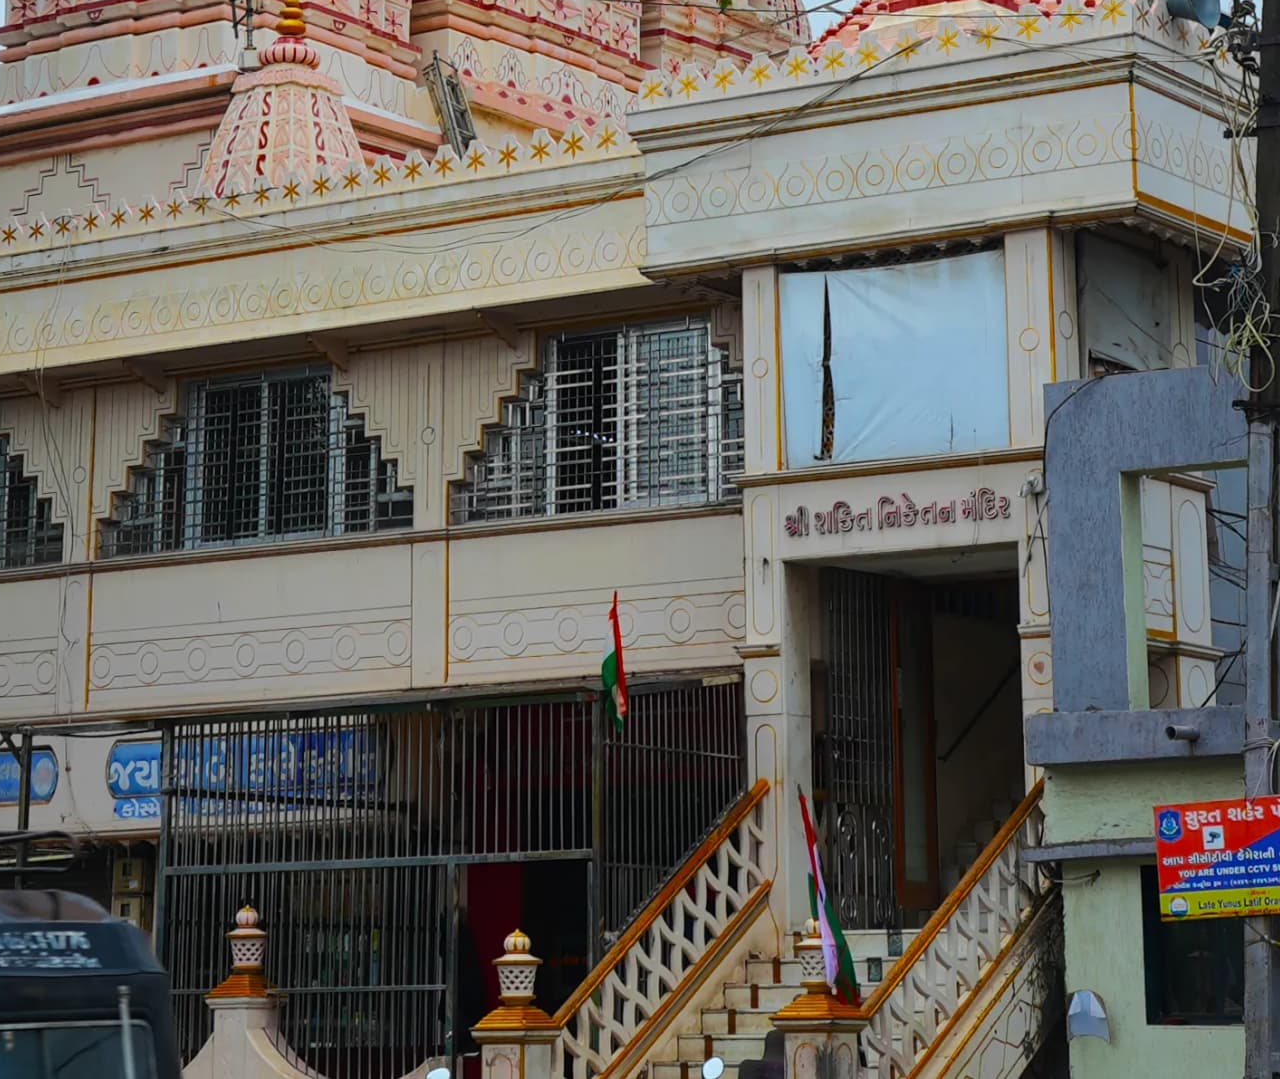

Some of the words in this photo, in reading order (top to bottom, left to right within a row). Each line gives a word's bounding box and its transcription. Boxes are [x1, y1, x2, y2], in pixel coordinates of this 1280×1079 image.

[784, 505, 809, 537] શ્રી
[877, 493, 956, 531] નિકેતન
[961, 487, 1011, 521] મંદિર
[1184, 809, 1222, 830] સુરત
[1227, 801, 1264, 821] શહેર
[1163, 856, 1184, 866] આપ
[1188, 851, 1232, 865] સીસીટીવી
[1178, 870, 1196, 879] YOU
[1198, 868, 1215, 877] ARE
[1216, 866, 1246, 876] UNDER
[1247, 864, 1271, 874] CCTV
[1198, 900, 1216, 911] Late
[1217, 898, 1242, 909] Yunus
[1243, 896, 1262, 908] Latif
